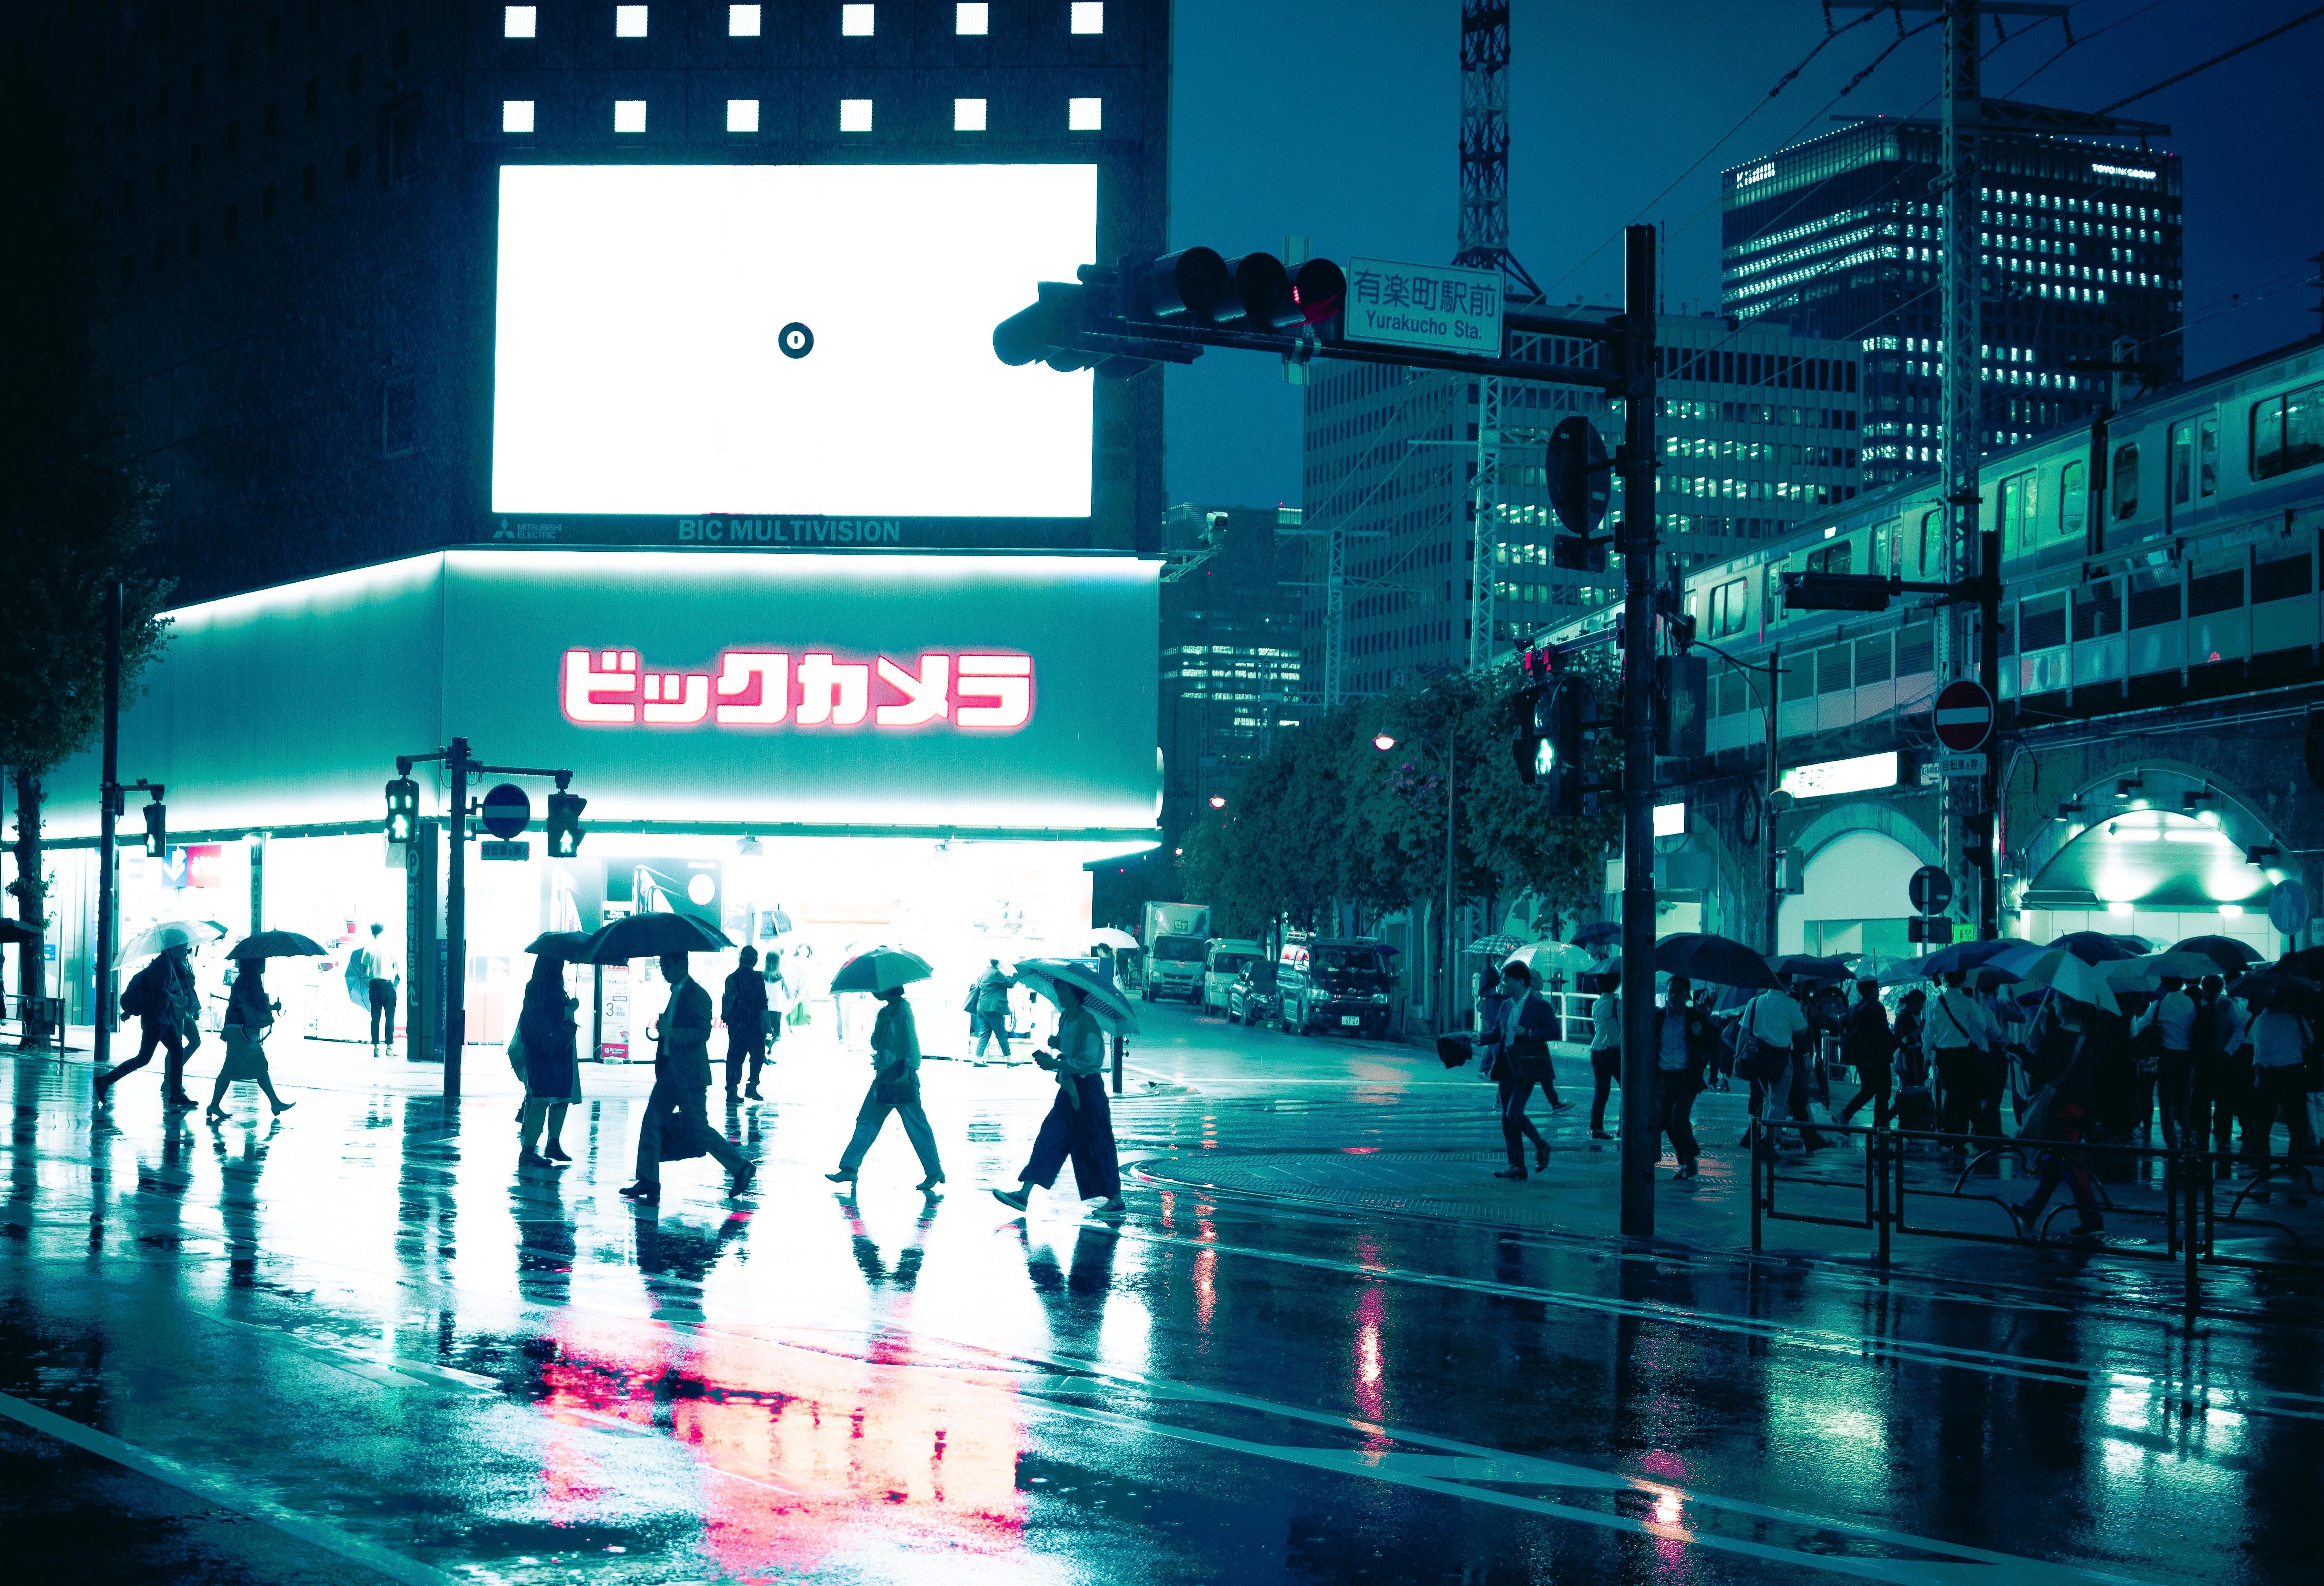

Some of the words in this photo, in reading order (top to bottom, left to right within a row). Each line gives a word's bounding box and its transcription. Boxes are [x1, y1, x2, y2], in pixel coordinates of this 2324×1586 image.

[2092, 163, 2115, 174] TOYO
[2115, 167, 2127, 175] INK
[2127, 168, 2156, 179] GROUP
[1353, 268, 1496, 318] 有楽町駅前
[1366, 309, 1447, 335] Yurakucho
[1454, 319, 1483, 339] Sta.
[678, 519, 723, 540] BIC
[731, 520, 900, 541] MULTIVISION
[562, 649, 1032, 728] ビックカメラ
[1943, 758, 1984, 771] 自転車を除く
[482, 844, 528, 857] 自転車を除く
